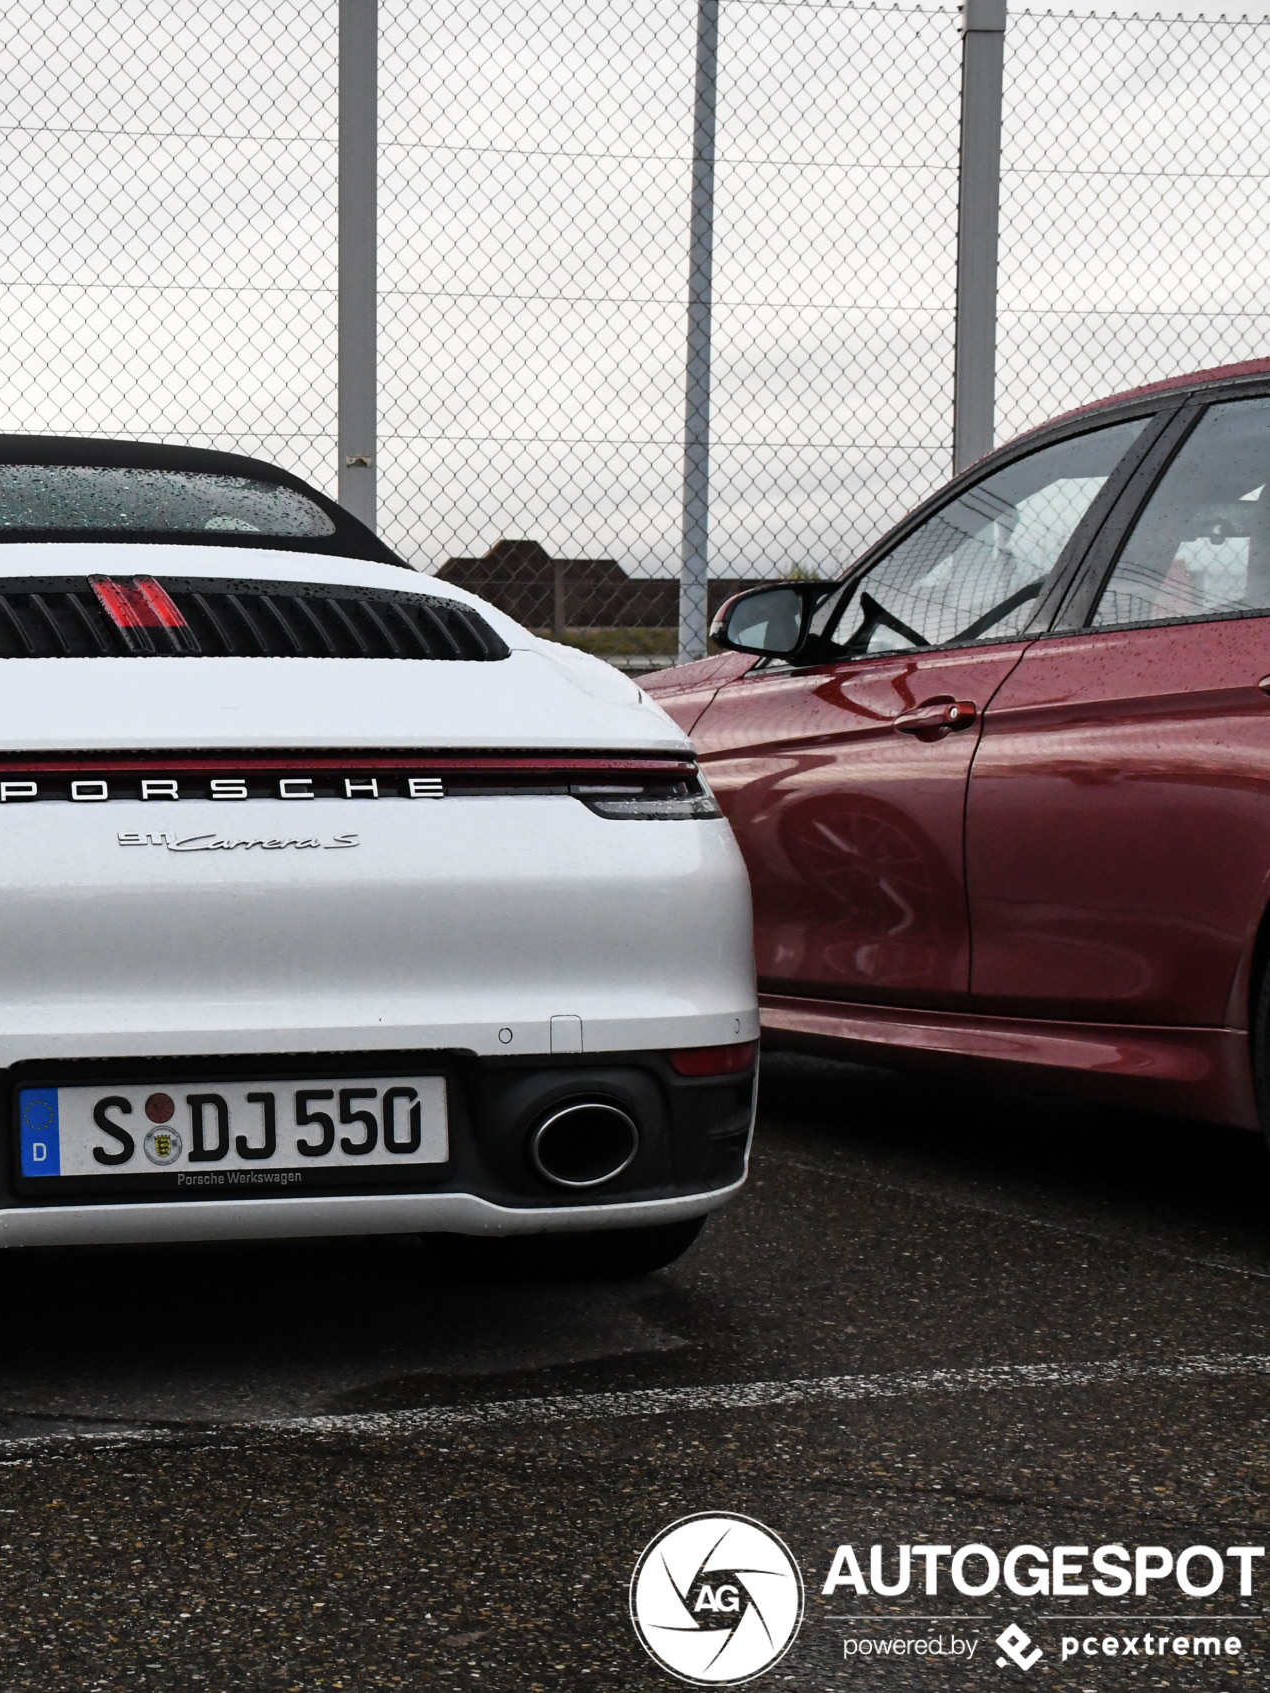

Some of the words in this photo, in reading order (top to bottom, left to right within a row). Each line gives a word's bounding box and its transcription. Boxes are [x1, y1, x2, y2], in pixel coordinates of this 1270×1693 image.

[0, 778, 445, 801] PORSCHE
[118, 831, 176, 847] 911
[168, 833, 322, 852] Carrera
[324, 833, 360, 849] S
[92, 1096, 135, 1166] S
[186, 1091, 276, 1162] DJ
[295, 1086, 422, 1158] 550
[32, 1142, 47, 1162] D
[177, 1172, 225, 1186] Porsche
[229, 1170, 302, 1186] Werkswagen
